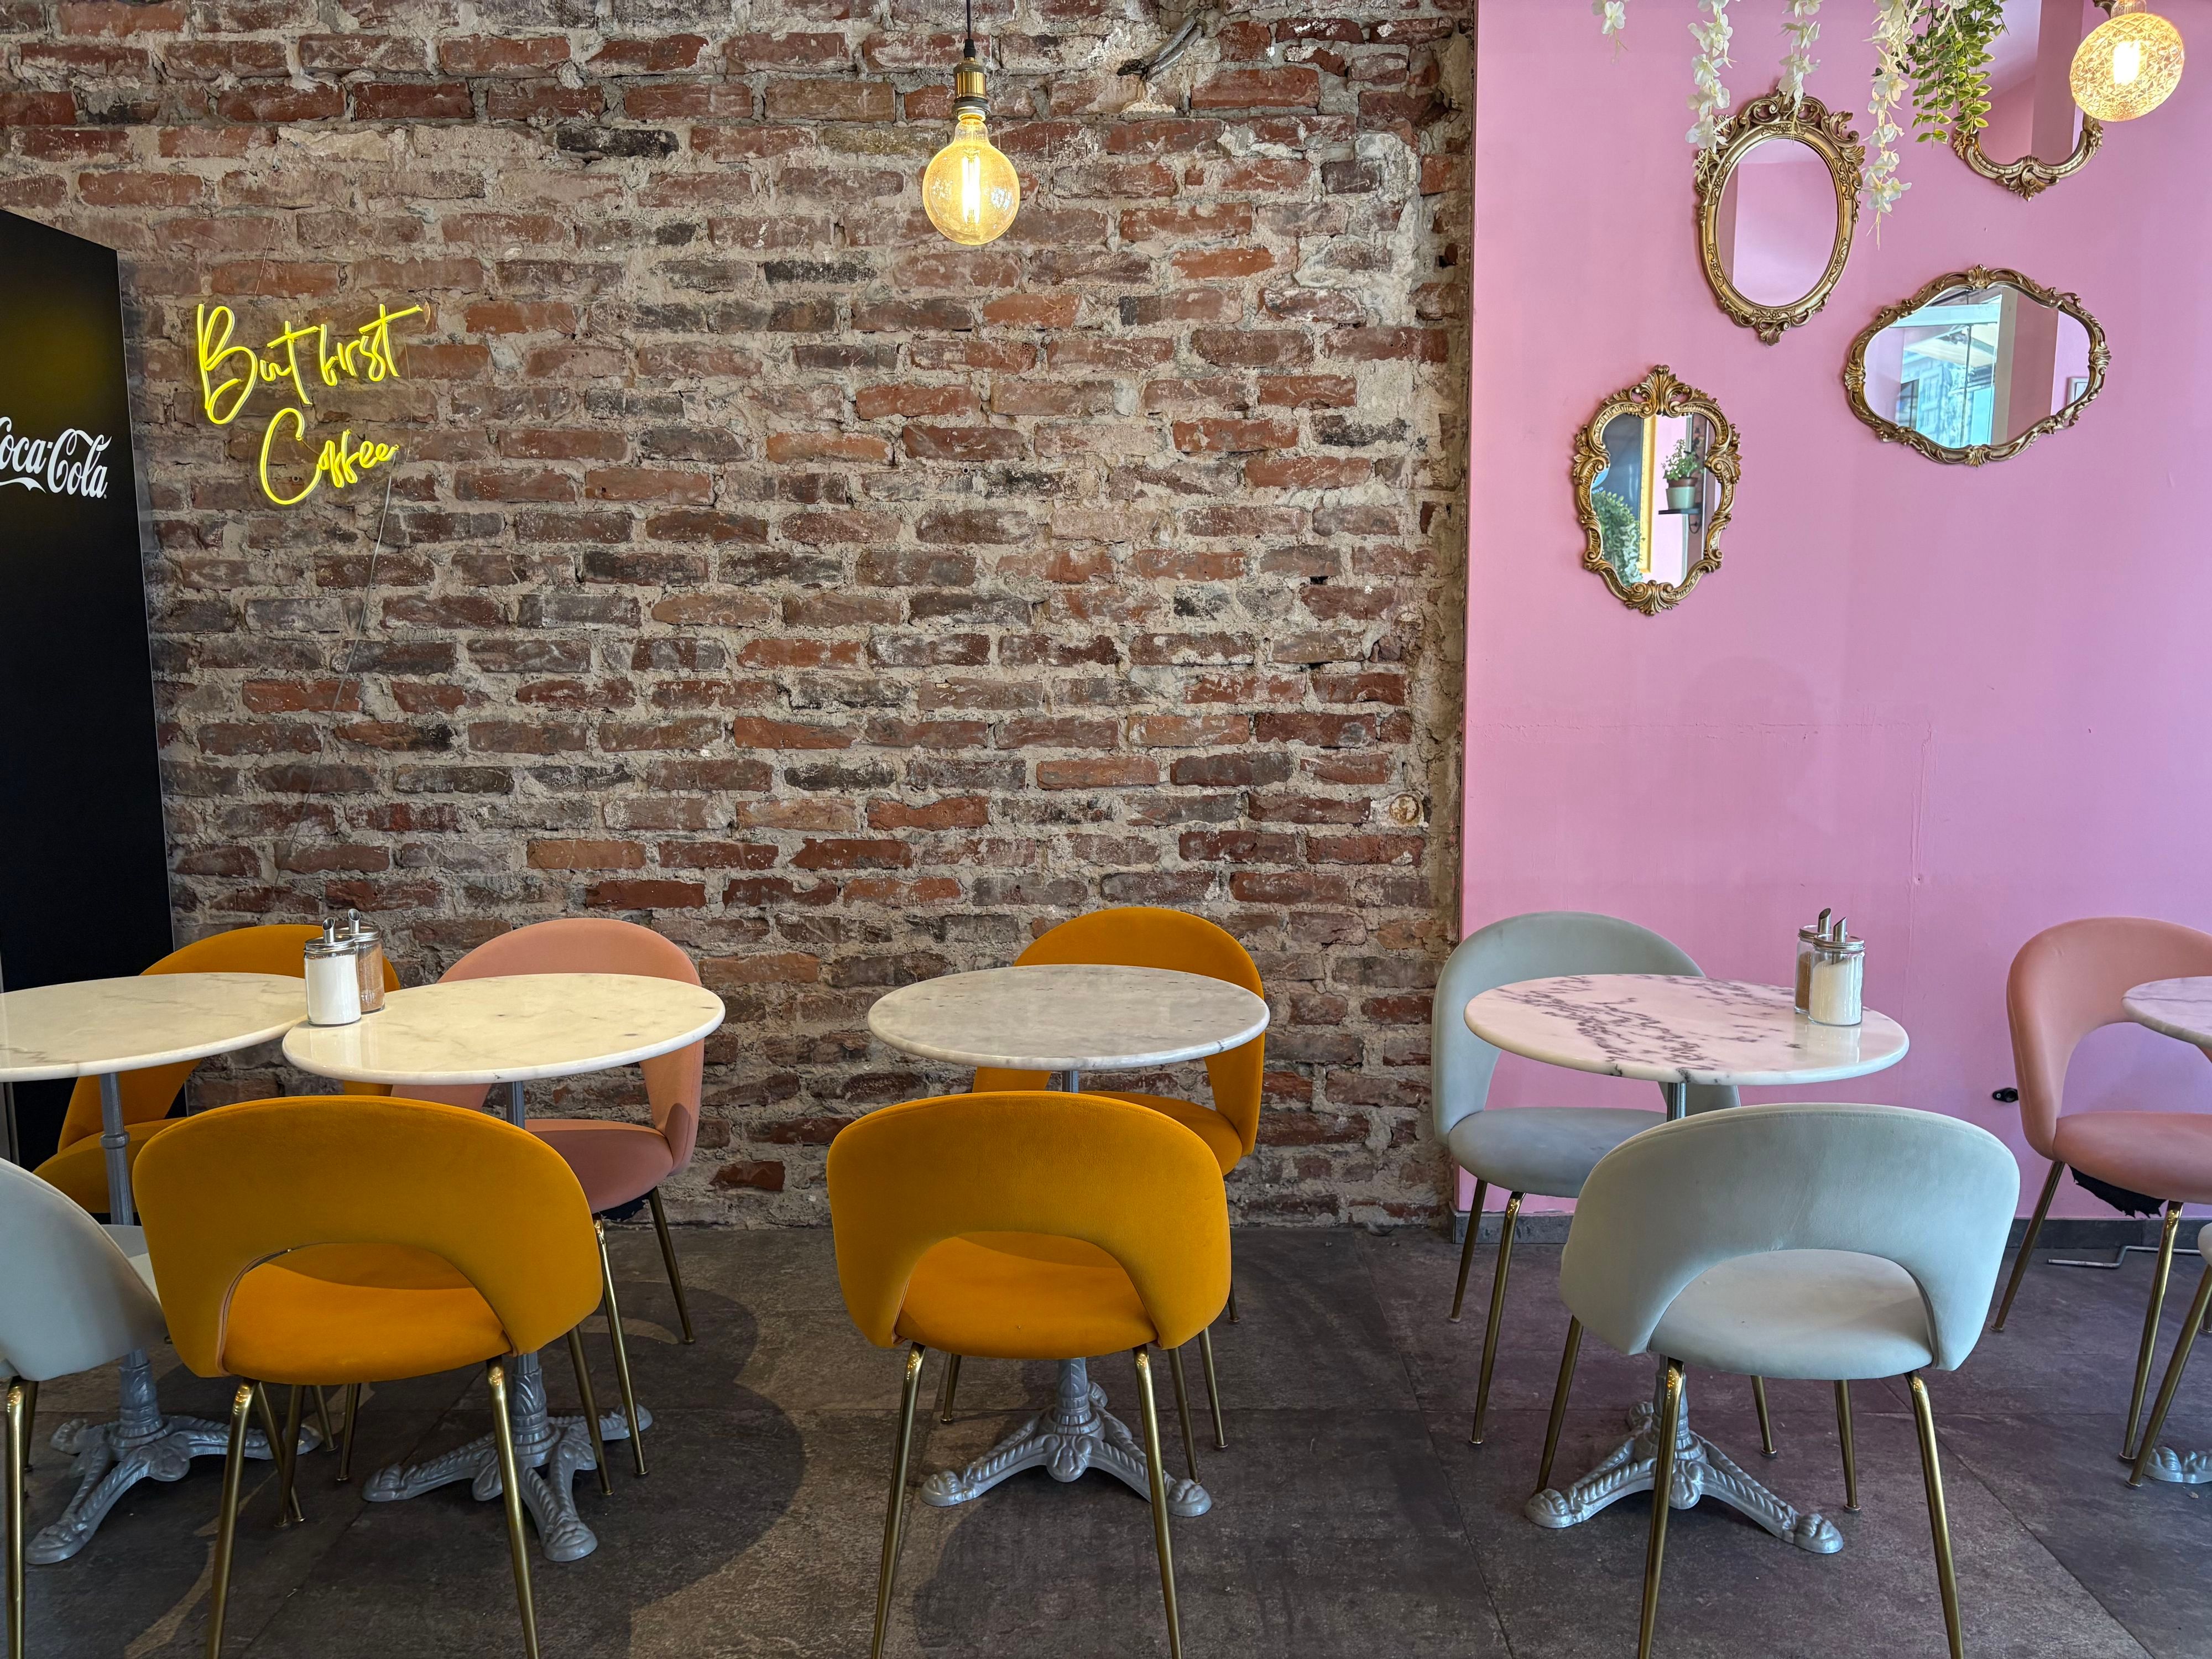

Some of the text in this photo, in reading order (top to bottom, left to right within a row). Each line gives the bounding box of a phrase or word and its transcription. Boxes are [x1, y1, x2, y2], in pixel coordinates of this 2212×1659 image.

[197, 303, 422, 424] But first
[260, 408, 399, 505] Coffee
